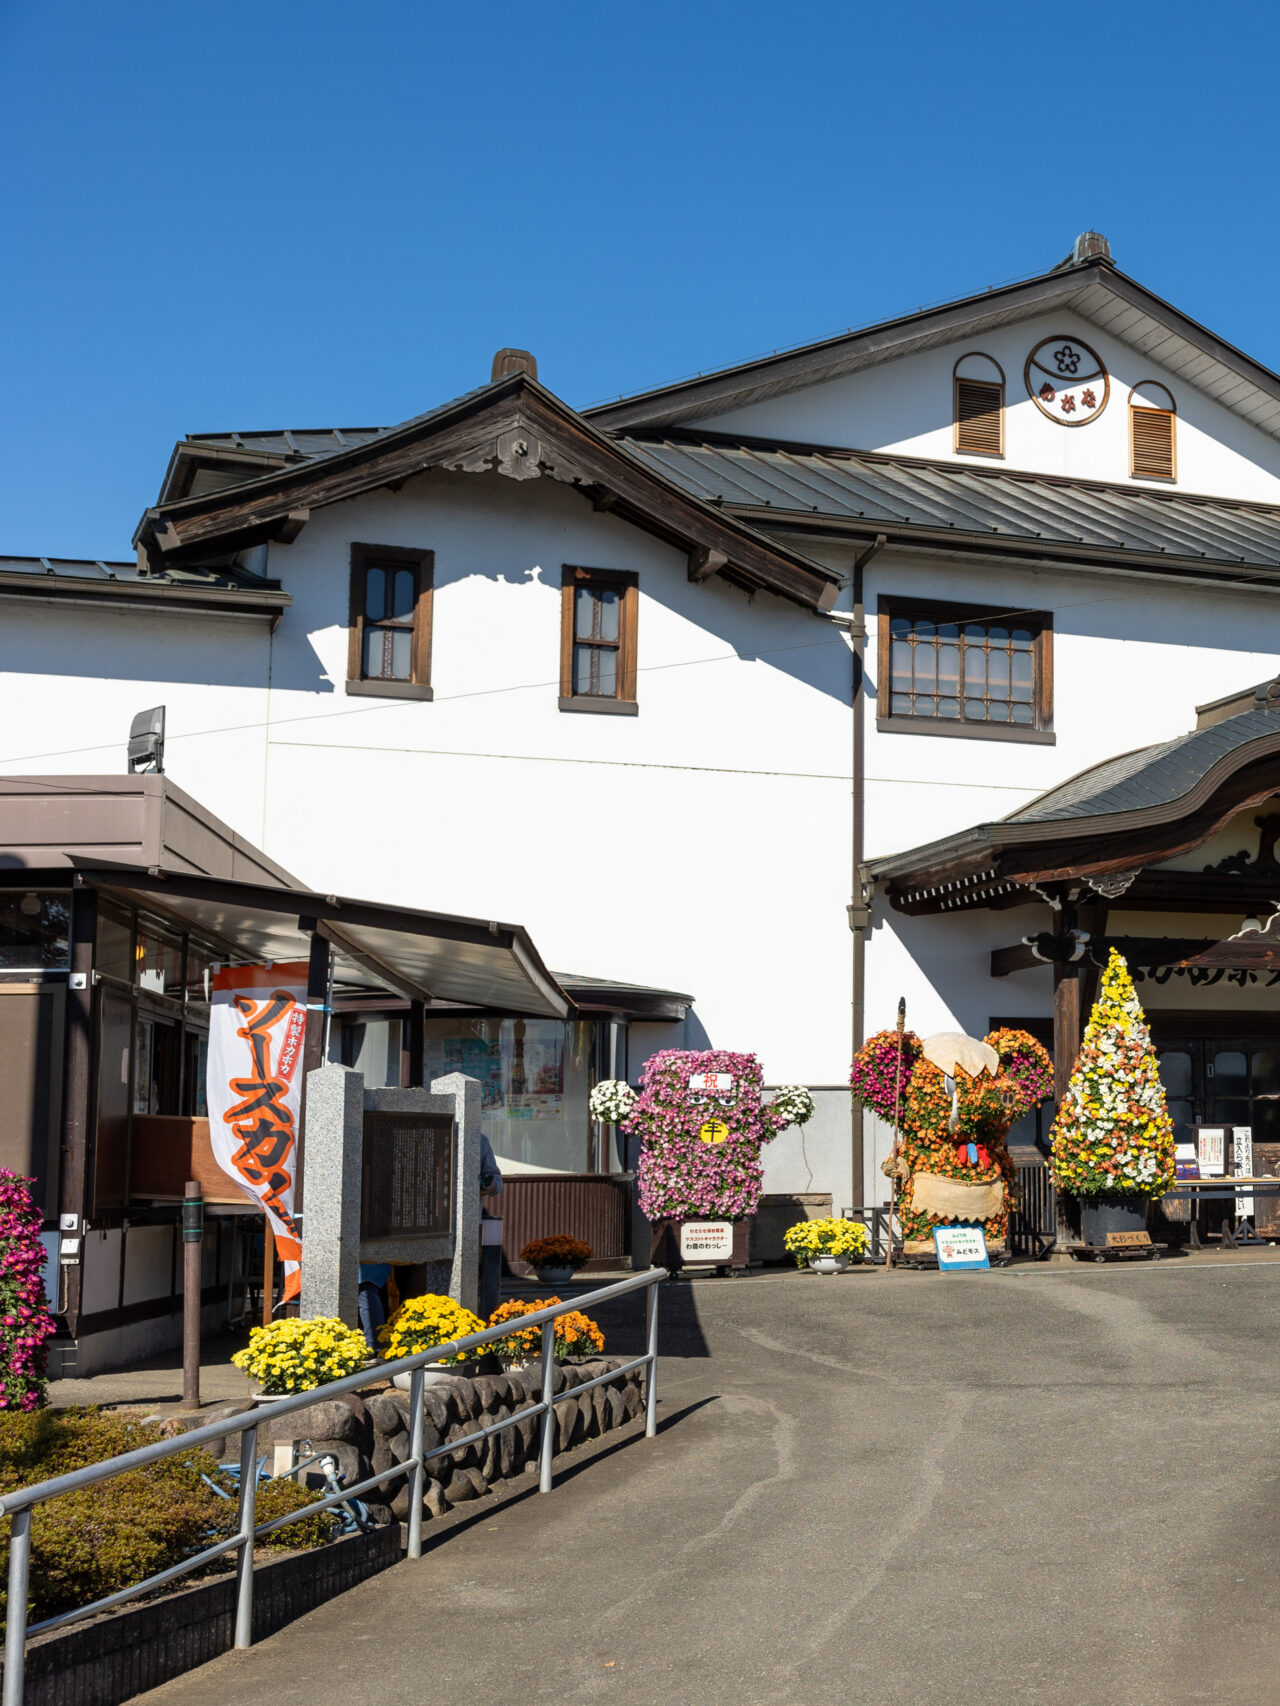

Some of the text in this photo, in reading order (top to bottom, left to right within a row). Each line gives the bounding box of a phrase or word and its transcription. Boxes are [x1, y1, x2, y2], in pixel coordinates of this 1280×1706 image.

[279, 1011, 305, 1075] 特製ホカホカ
[703, 1074, 718, 1088] 祝
